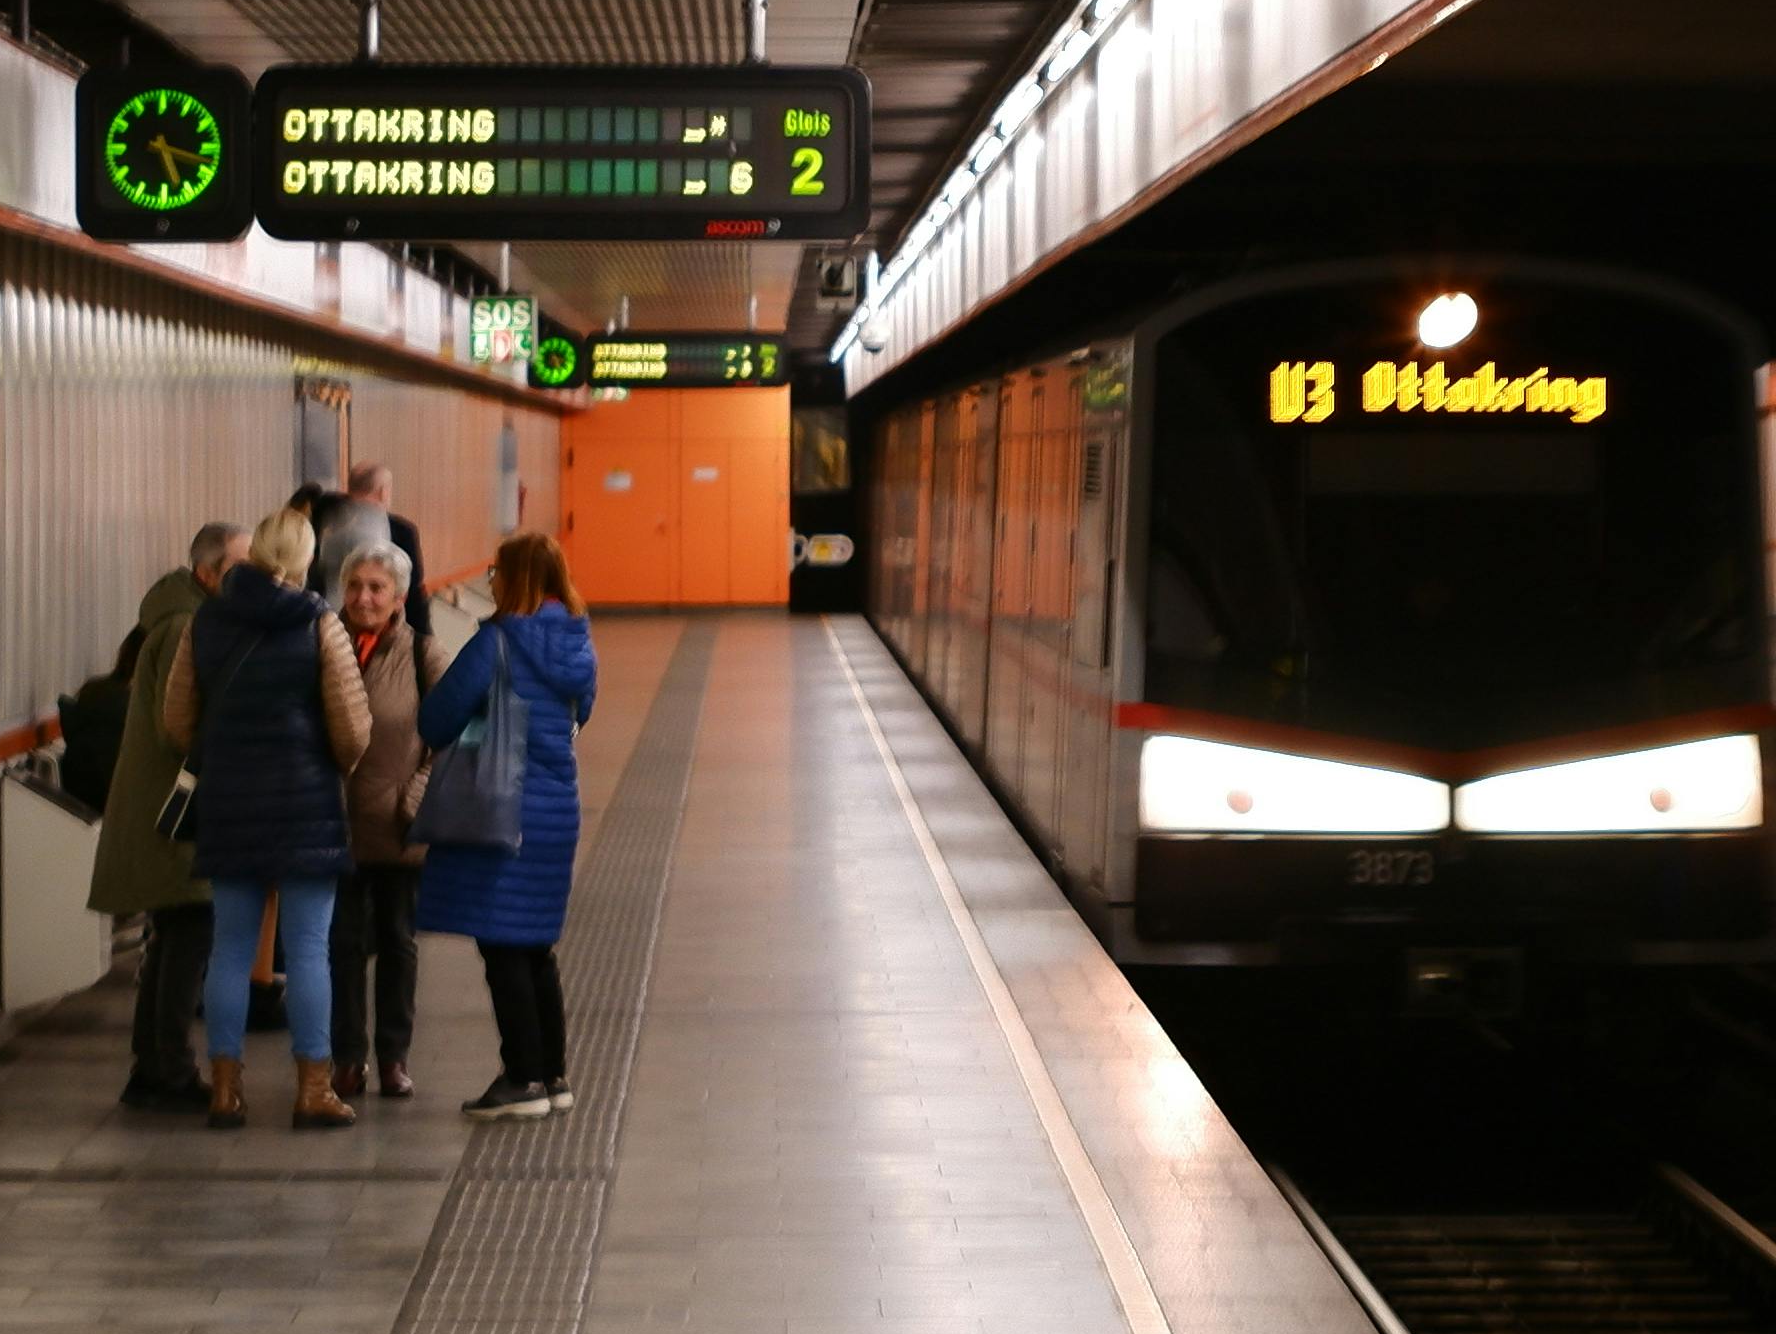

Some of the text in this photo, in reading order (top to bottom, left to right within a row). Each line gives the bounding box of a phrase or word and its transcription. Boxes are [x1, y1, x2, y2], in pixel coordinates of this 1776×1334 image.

[283, 108, 495, 142] OTTAKRING
[283, 160, 753, 195] OTTAKRING 6
[790, 147, 824, 195] 2
[705, 219, 765, 236] ascom
[473, 300, 531, 330] SOS
[1270, 361, 1606, 423] U3 Ottakring
[1347, 849, 1434, 885] 3873
